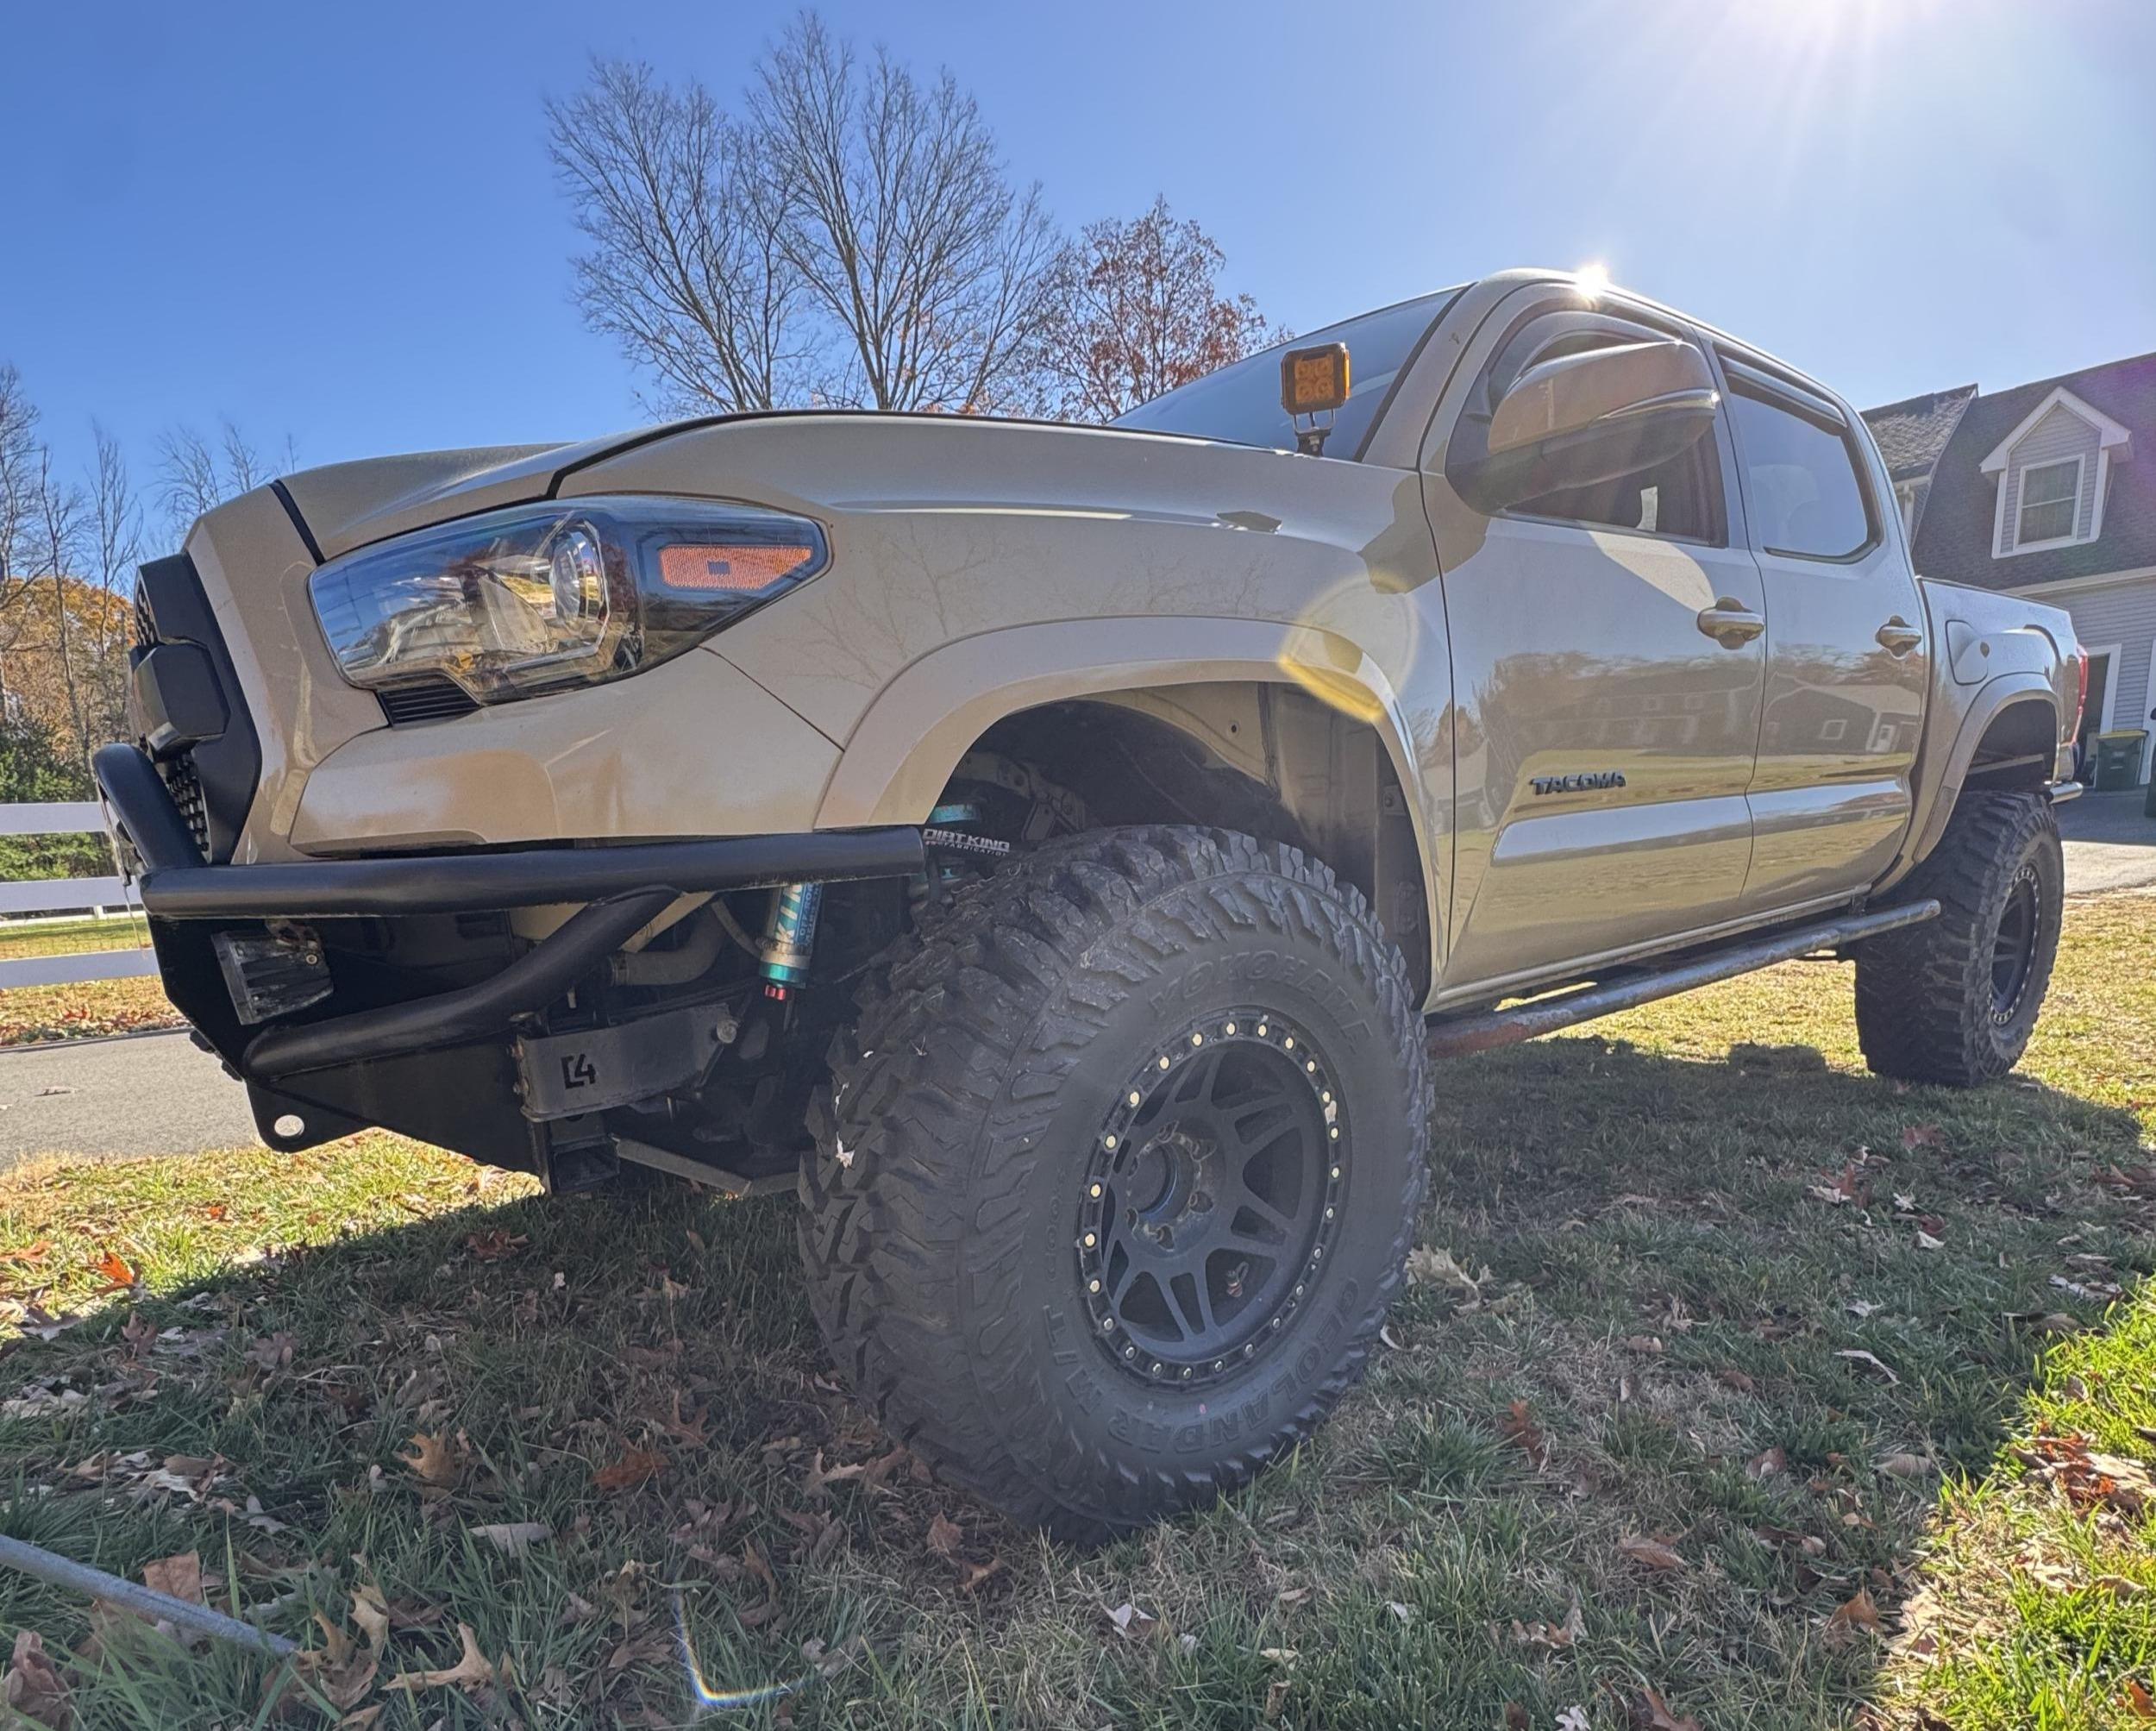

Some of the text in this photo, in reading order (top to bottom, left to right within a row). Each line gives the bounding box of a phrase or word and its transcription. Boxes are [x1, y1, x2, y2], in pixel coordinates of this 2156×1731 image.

[1530, 772, 1626, 795] TACOMA
[775, 883, 802, 944] KIN
[1148, 950, 1374, 1055] YOKOHAMA
[561, 1053, 596, 1088] C4
[1107, 1277, 1360, 1454] GEOLANDAR
